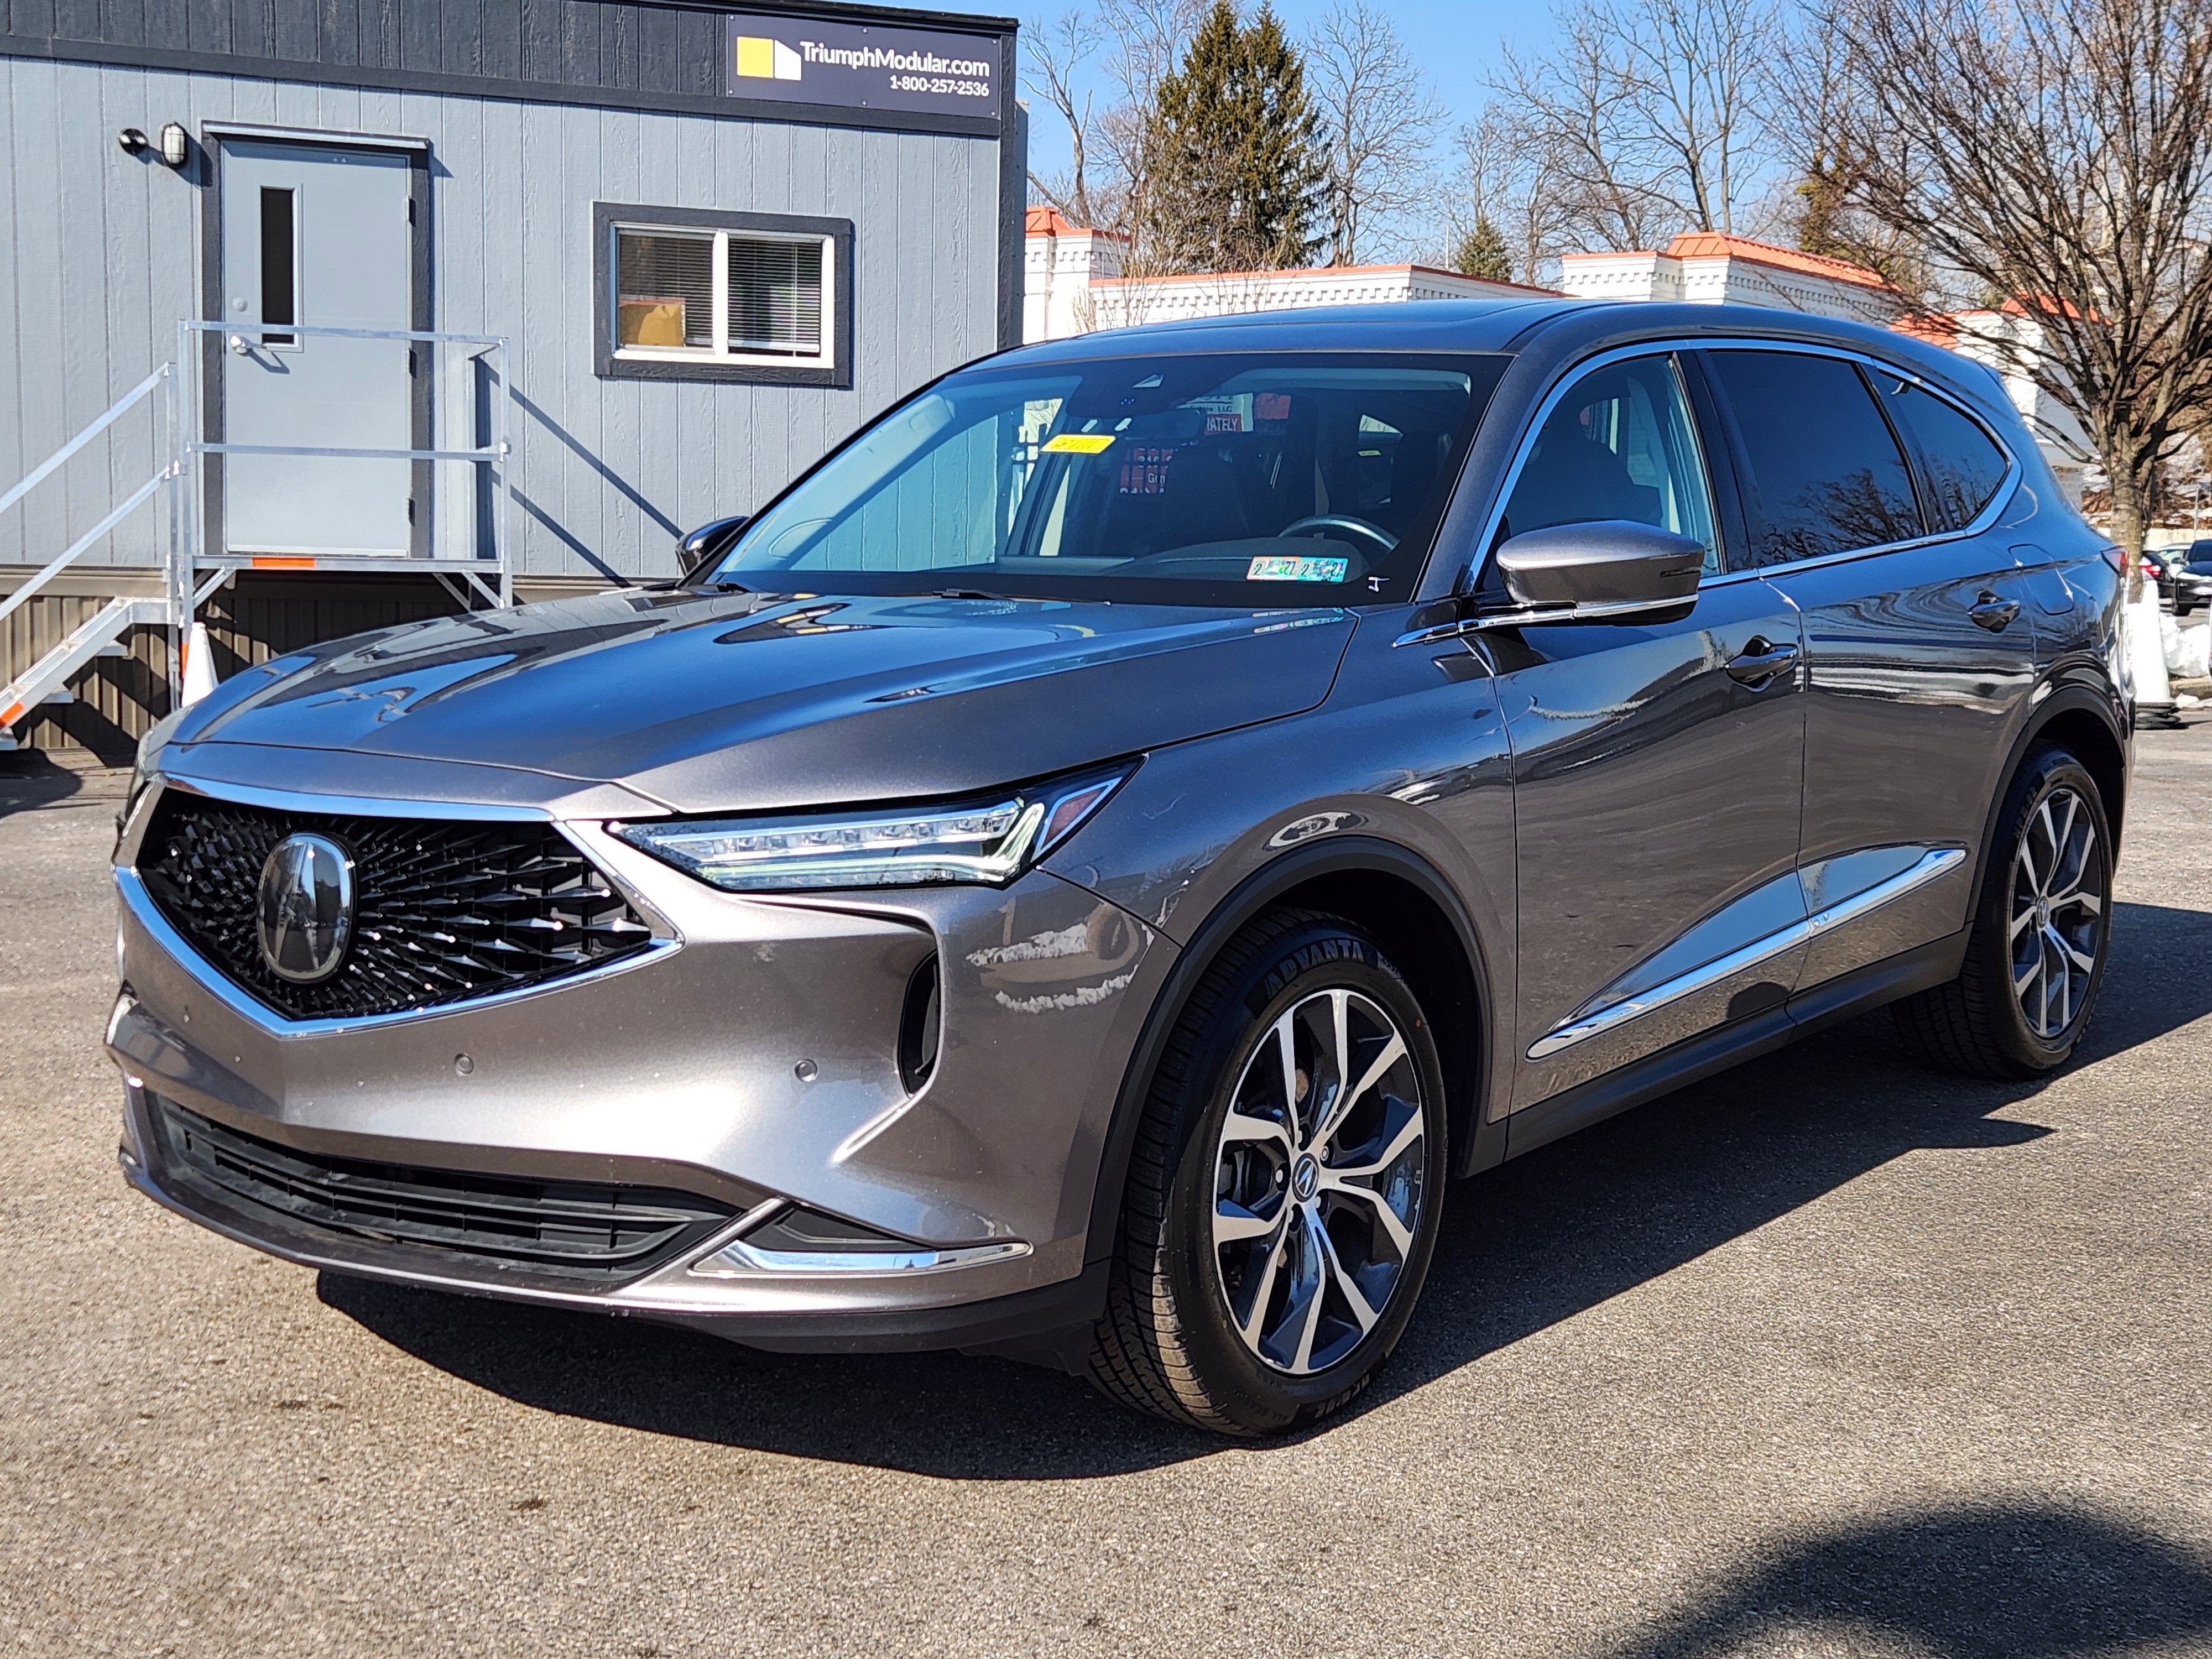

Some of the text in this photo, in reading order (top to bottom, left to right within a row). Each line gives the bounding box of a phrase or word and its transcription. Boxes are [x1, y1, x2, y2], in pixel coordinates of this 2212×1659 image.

[800, 40, 990, 77] TriumphModular.com
[890, 75, 990, 97] 1-800-257-2536
[1264, 939, 1364, 999] ADVANTA
